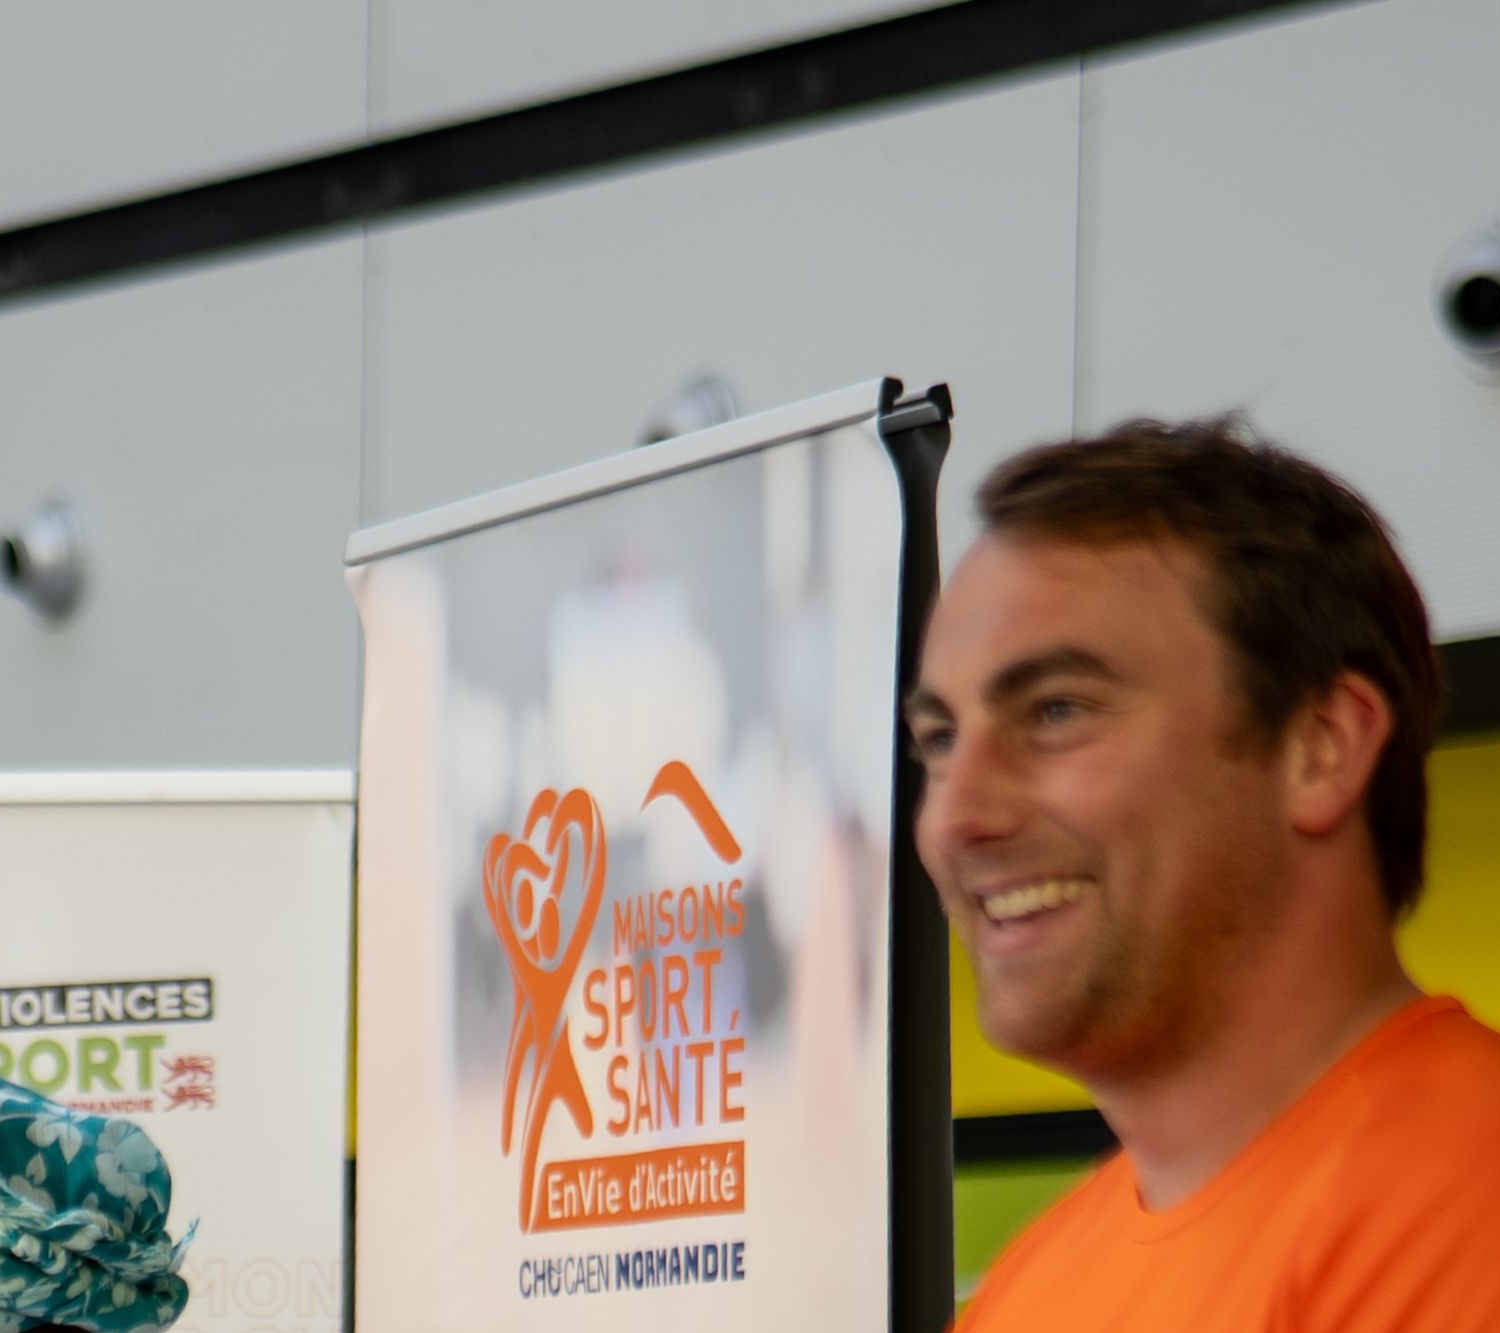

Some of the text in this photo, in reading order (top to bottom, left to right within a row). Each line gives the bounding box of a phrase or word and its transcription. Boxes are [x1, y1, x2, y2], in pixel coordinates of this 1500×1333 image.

[614, 878, 745, 956] MAISONS
[583, 948, 722, 1051] SPORT
[66, 1096, 155, 1115] MANDIE
[606, 1009, 745, 1137] SANTÉ
[548, 1154, 736, 1221] EnVie d'Activité
[519, 1241, 745, 1299] CHU CAEN NORMANDIE
